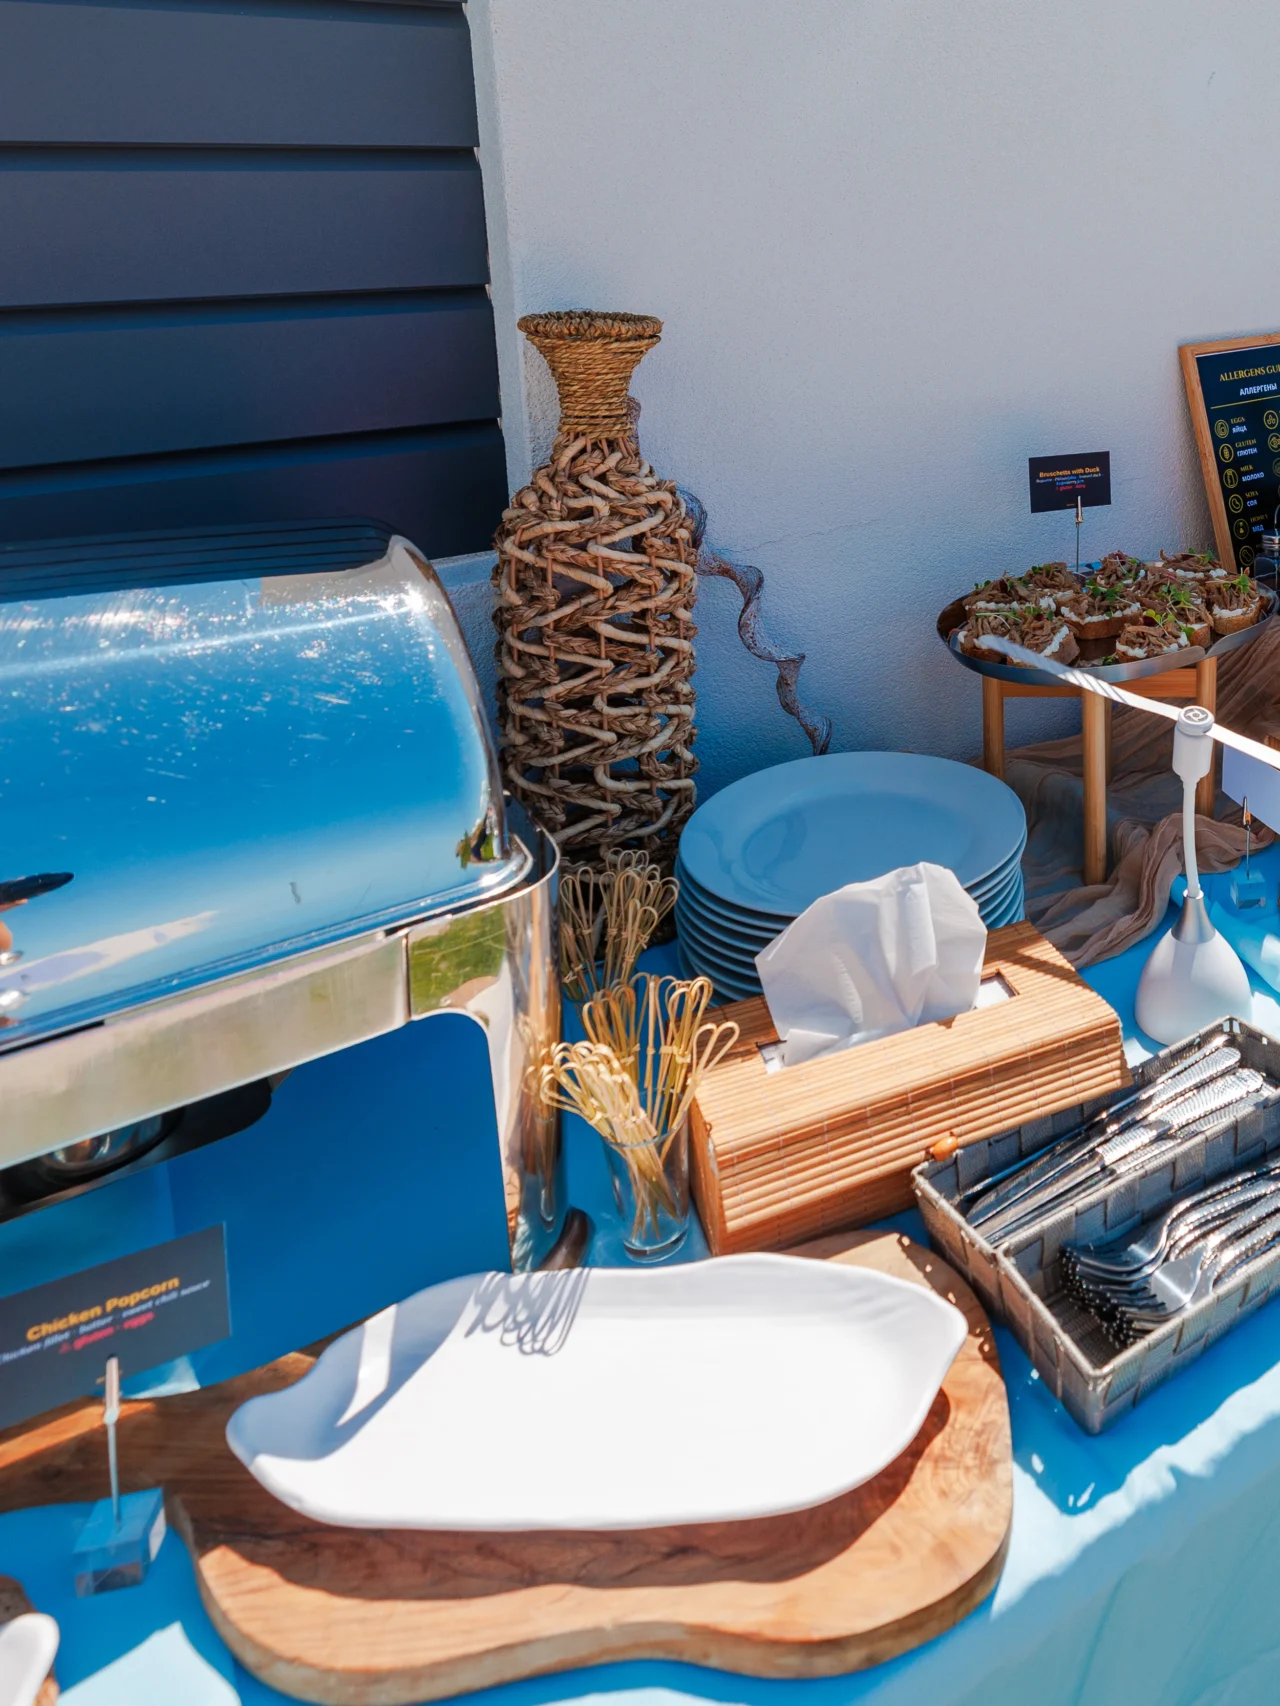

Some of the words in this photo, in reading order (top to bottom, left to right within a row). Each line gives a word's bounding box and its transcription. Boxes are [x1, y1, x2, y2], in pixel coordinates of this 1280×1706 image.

[1219, 366, 1265, 381] ALLERGENS
[1239, 383, 1278, 396] АЛЛЕРГЕНЫ
[1230, 416, 1246, 425] EGGS
[1232, 425, 1248, 434] ЯЙЦА
[1235, 438, 1257, 448] GLUTEN
[1236, 447, 1258, 457] ГЛЮТЕН
[1240, 464, 1254, 472] MILK
[1241, 471, 1265, 482] МОЛОКО
[1246, 499, 1258, 507] СОЯ
[26, 1304, 102, 1342] Chicken
[105, 1277, 180, 1313] Popcorn
[73, 1326, 115, 1351] gluten
[122, 1311, 155, 1331] eggs
